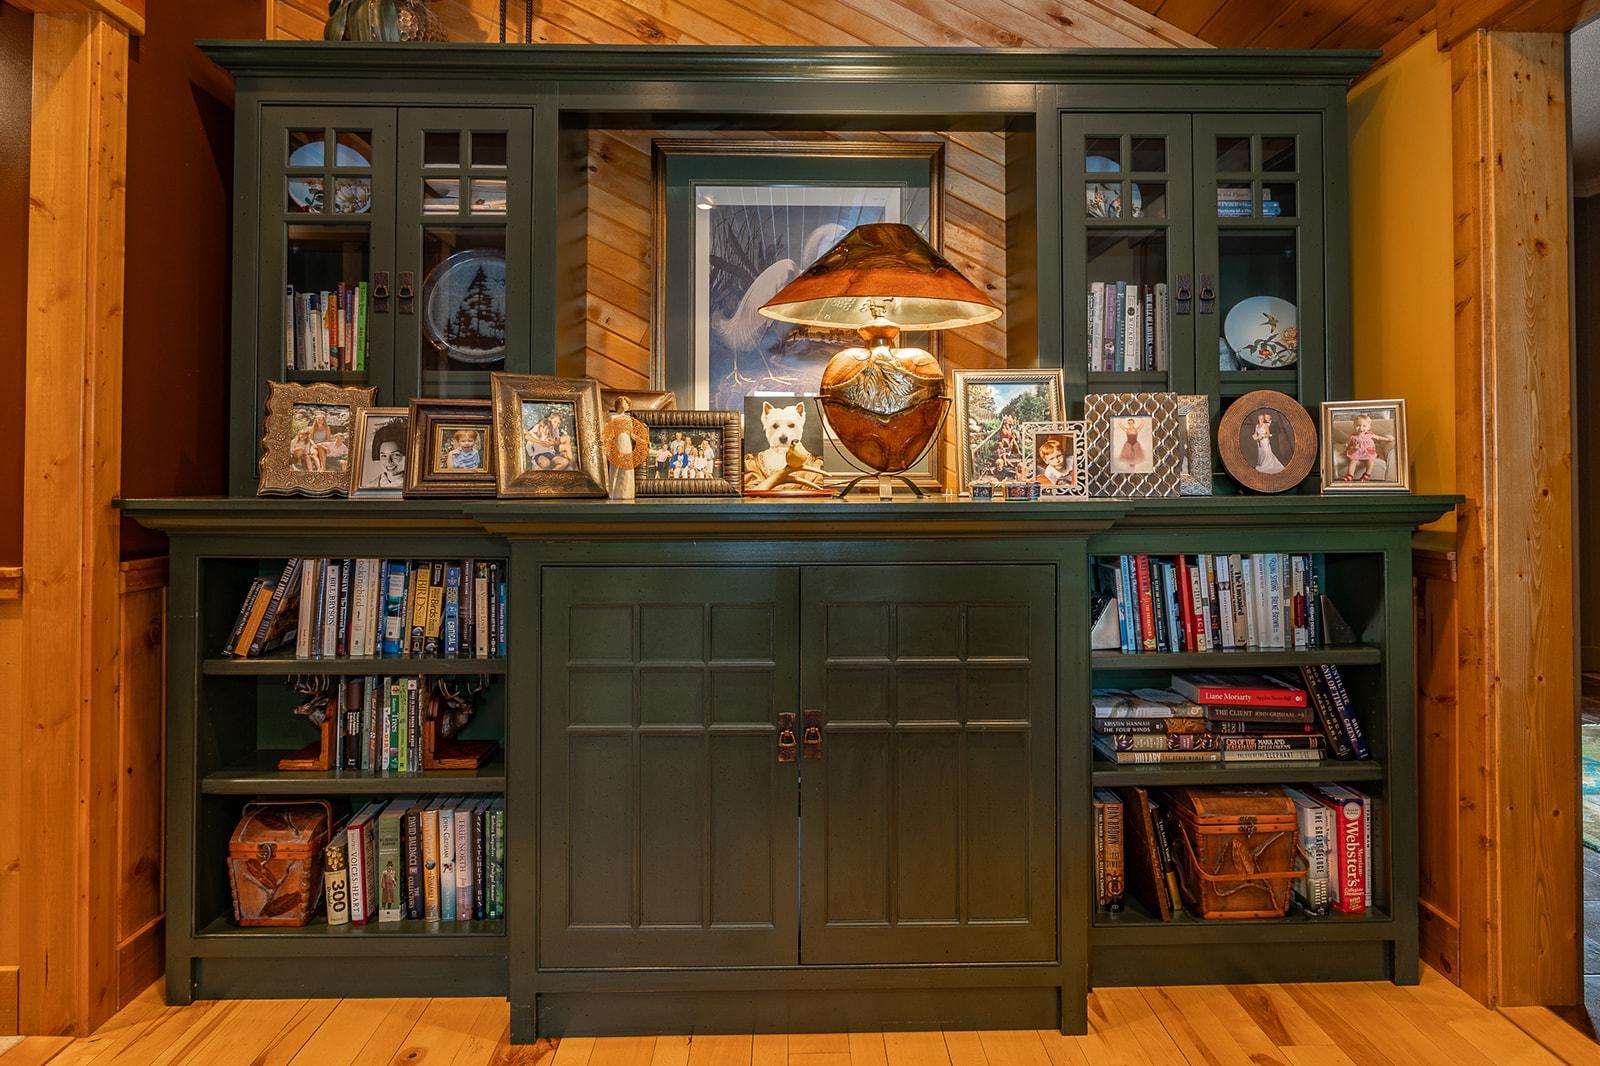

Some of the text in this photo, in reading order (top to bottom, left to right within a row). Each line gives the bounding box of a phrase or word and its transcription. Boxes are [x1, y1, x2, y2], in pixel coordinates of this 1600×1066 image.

[356, 560, 366, 608] ockingbird
[416, 580, 427, 612] BIRDS
[328, 595, 336, 625] BRYSON
[430, 599, 439, 618] Birds
[1223, 693, 1251, 702] Moriarty
[1321, 664, 1344, 712] END OF TIME
[1330, 664, 1350, 705] UNTIL THE
[391, 713, 399, 733] Trees
[1229, 709, 1253, 717] CLIENT
[1351, 718, 1362, 738] BRIAN
[1343, 718, 1358, 743] GREENE
[1134, 752, 1161, 763] HILLARY
[408, 817, 417, 865] DAVID BALDACCI
[442, 816, 451, 858] JOHN GRISHAM
[1106, 806, 1120, 845] DAN BROWN
[459, 842, 467, 873] NORTH
[1315, 812, 1324, 873] THE GREAT DELUGE
[1346, 820, 1360, 887] Webster's
[332, 880, 346, 913] 300
